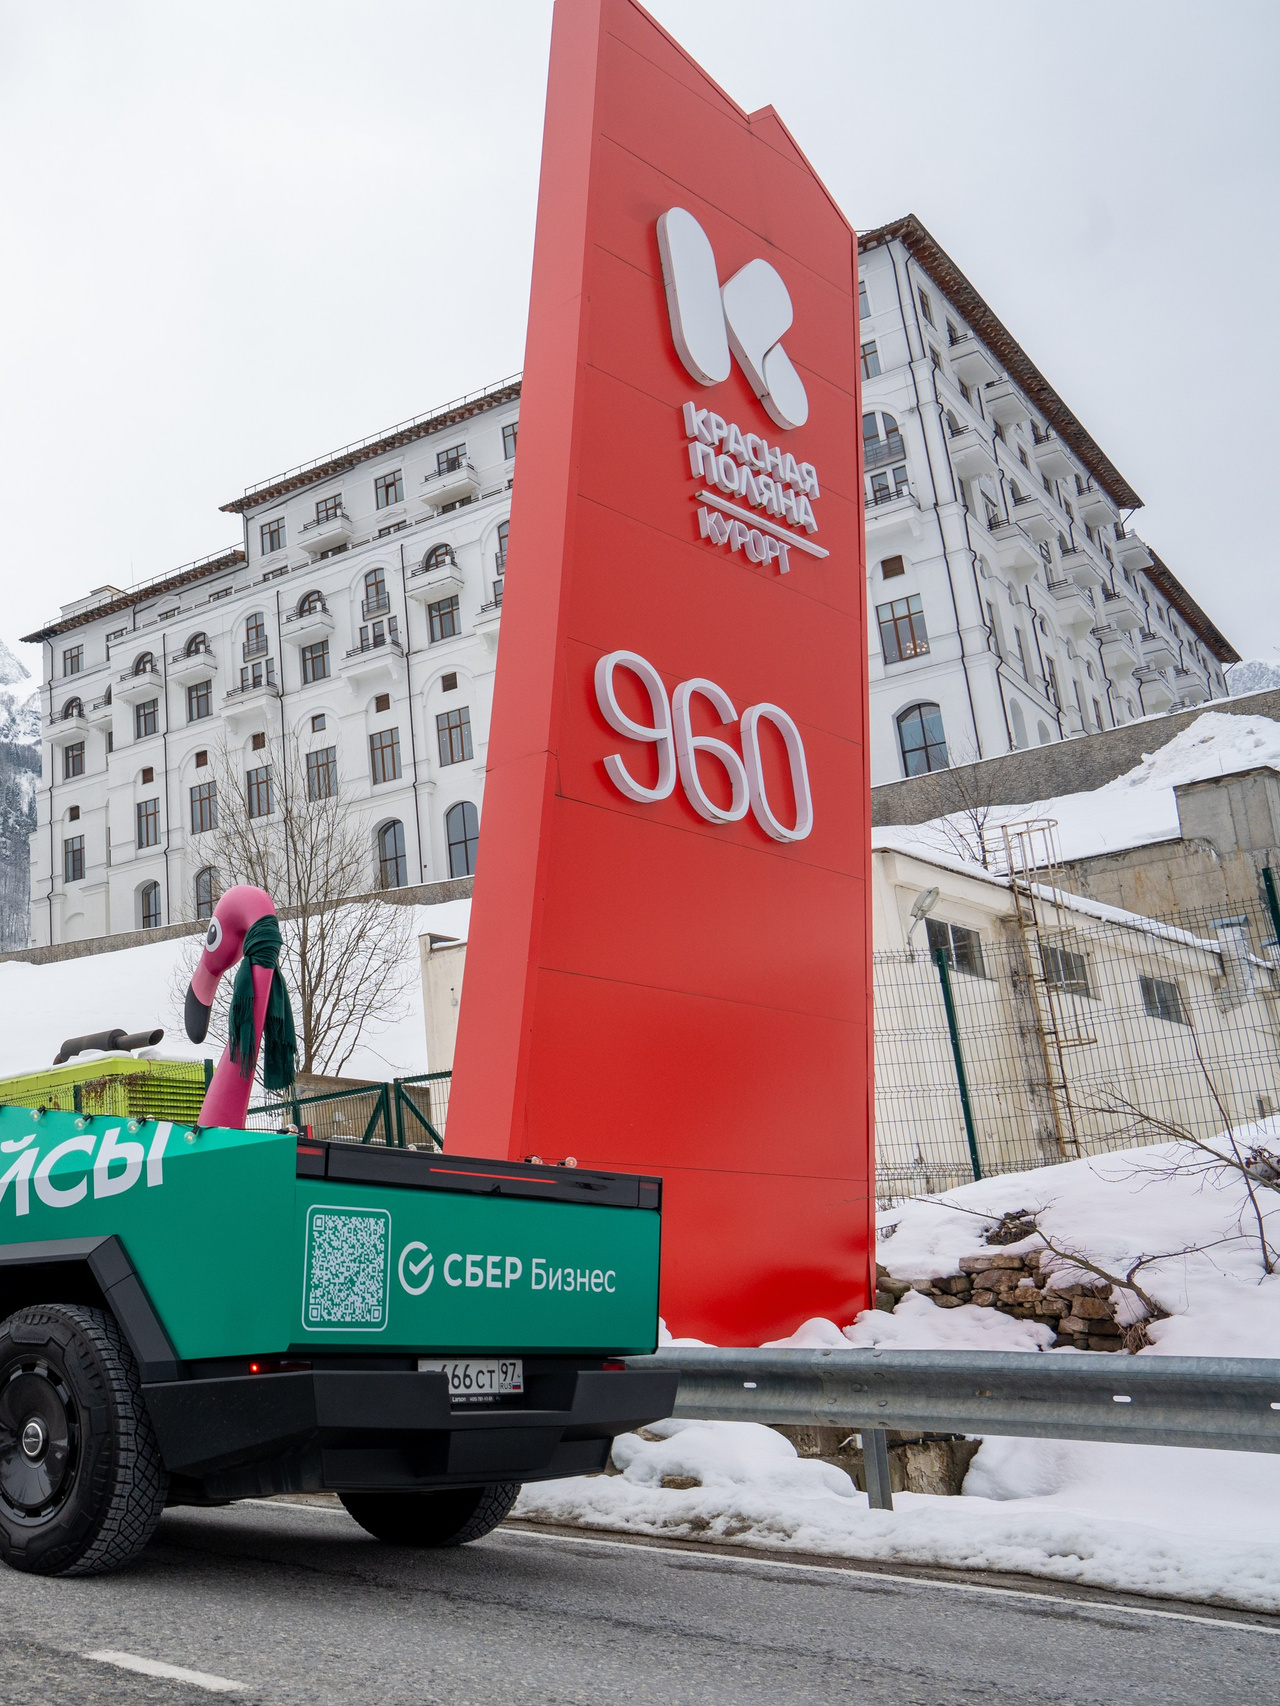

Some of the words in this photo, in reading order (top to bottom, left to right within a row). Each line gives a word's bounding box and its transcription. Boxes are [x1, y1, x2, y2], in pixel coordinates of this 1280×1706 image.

[683, 401, 820, 500] КРАСНАЯ
[688, 441, 818, 534] ПОЛЯНА
[697, 506, 790, 574] КУРОРТ
[594, 650, 813, 843] 960
[443, 1253, 523, 1289] СБЕР
[531, 1258, 616, 1293] Бизнес
[500, 1362, 516, 1382] 97
[500, 1382, 512, 1390] RUS
